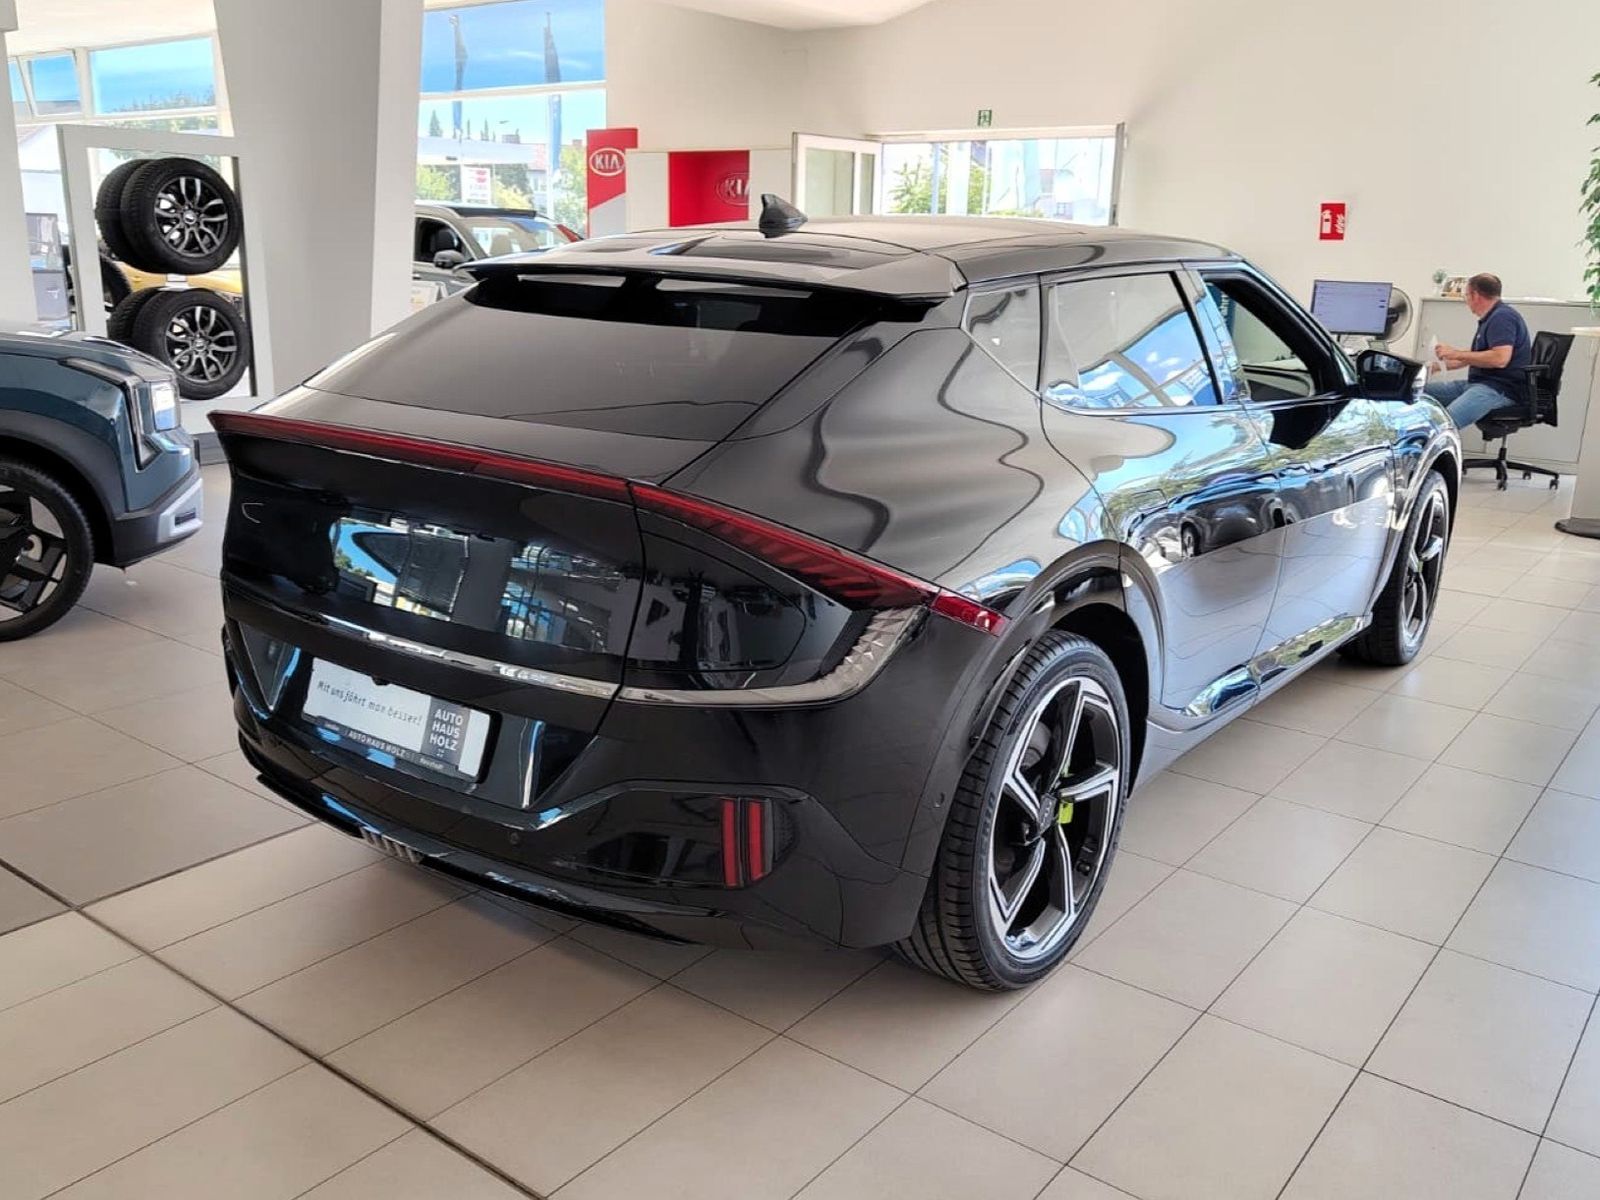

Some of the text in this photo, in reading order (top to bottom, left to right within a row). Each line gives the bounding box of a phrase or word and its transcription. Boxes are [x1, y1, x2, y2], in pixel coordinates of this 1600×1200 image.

[595, 154, 620, 169] KIA
[434, 708, 464, 726] AUTO
[431, 720, 461, 739] HAUS
[385, 742, 406, 757] HOLZ
[429, 733, 458, 751] HOLZ
